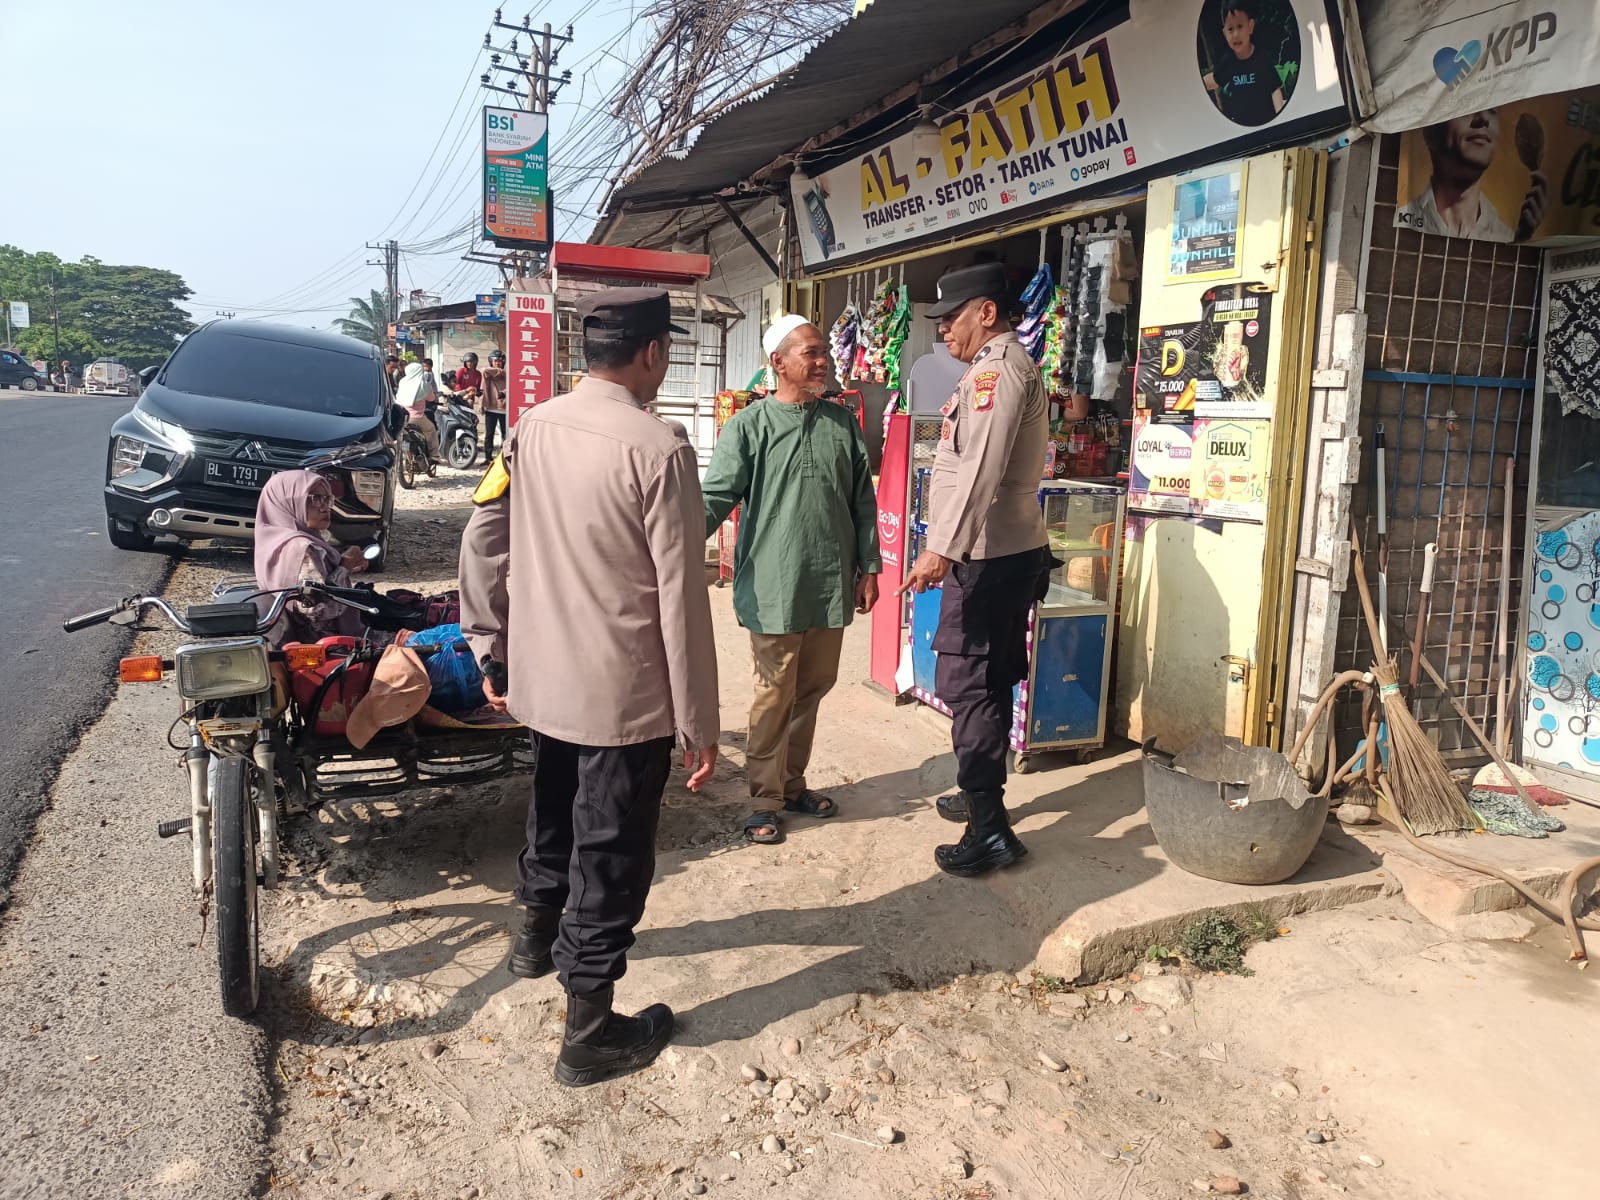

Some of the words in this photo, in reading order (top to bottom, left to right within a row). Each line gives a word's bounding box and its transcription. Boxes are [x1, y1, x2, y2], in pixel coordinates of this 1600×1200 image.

[1479, 11, 1557, 72] KPP
[1232, 73, 1256, 86] SMILE
[940, 37, 1120, 179] FATIH
[488, 113, 515, 131] BSI
[488, 131, 505, 139] BANK
[525, 153, 544, 162] MINI
[525, 162, 543, 170] ATM
[863, 195, 925, 229] TRANSFER
[936, 173, 986, 206] SETOR
[998, 146, 1055, 184] TARIK
[1058, 118, 1129, 163] TUNAI
[1080, 157, 1111, 179] gopay
[1036, 178, 1055, 191] DANA
[969, 197, 988, 214] OVO
[1172, 220, 1237, 240] DUNHILL
[516, 297, 545, 310] TOKO
[1137, 440, 1163, 453] LOYAL
[1210, 441, 1247, 457] DELUX
[208, 462, 222, 477] BL
[232, 466, 259, 481] 1791
[1158, 476, 1190, 489] 11.000
